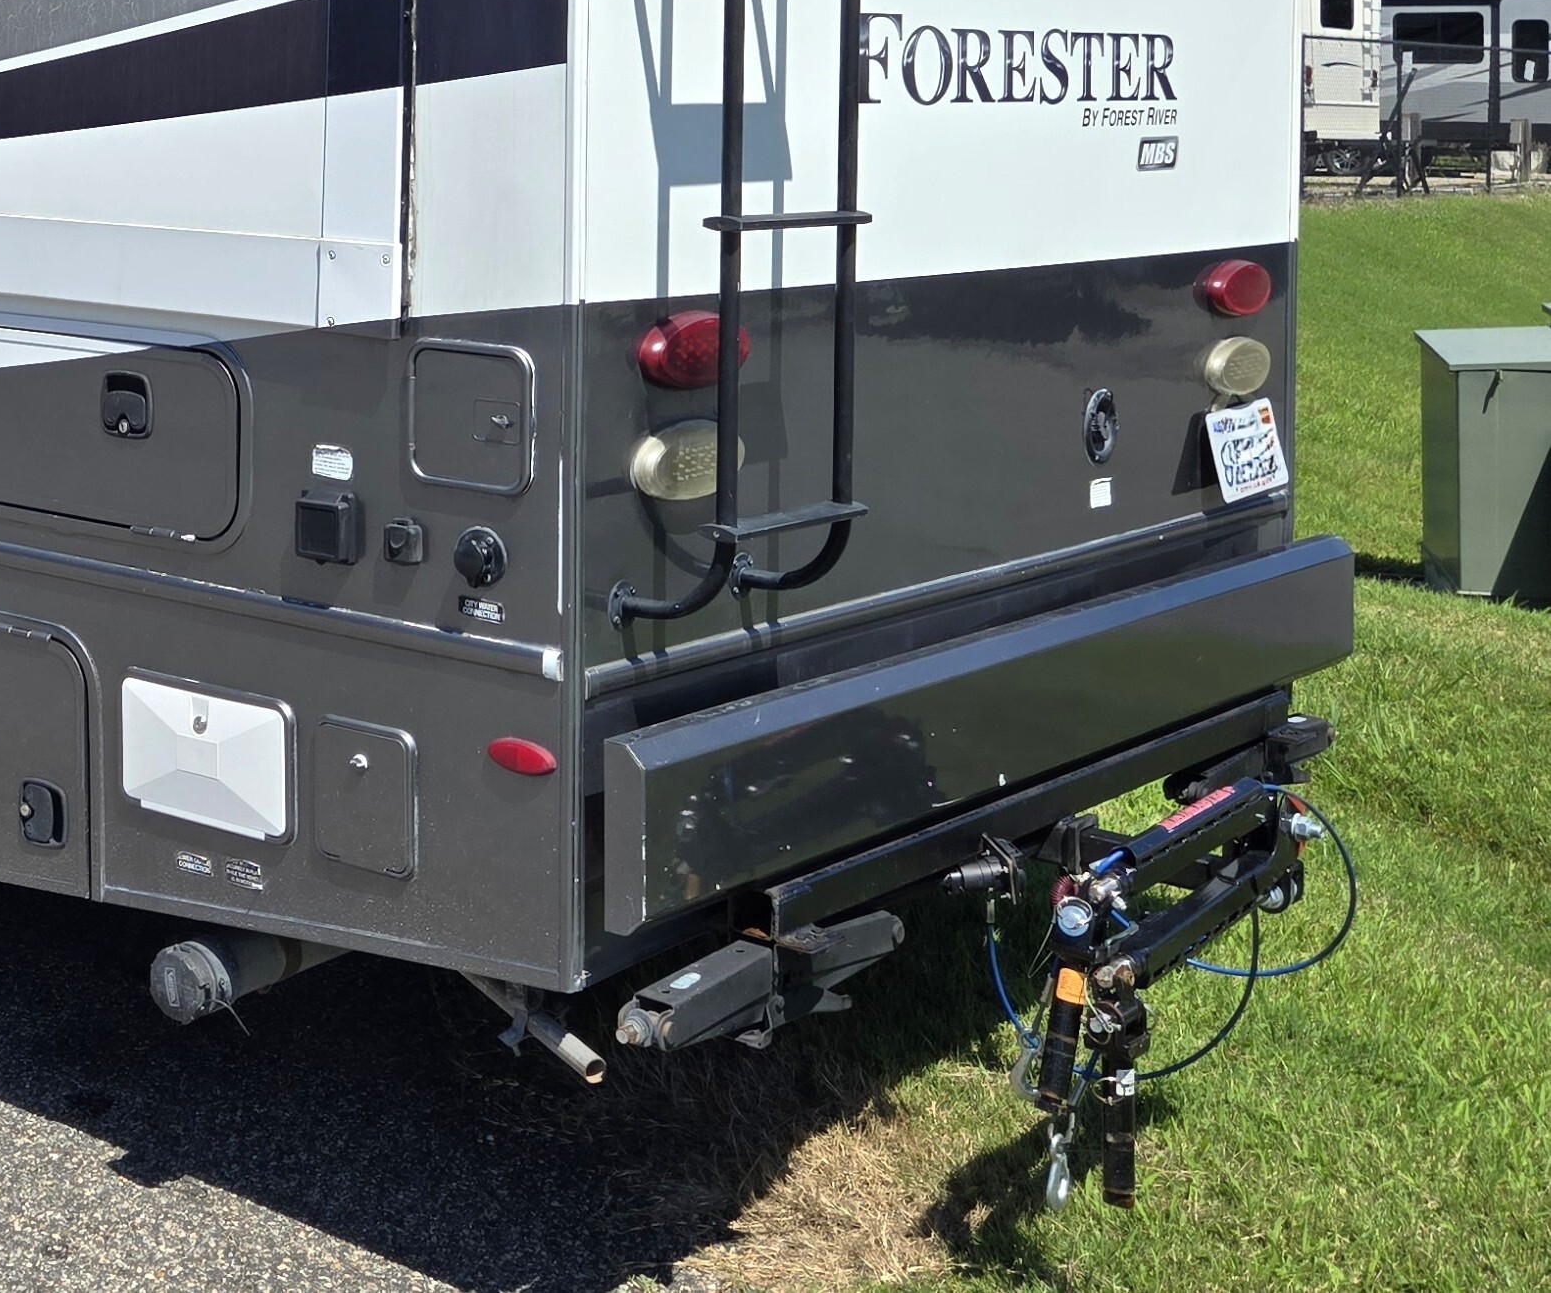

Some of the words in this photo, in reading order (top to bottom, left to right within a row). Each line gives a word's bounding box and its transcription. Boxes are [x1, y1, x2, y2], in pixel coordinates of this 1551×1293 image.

[858, 12, 1178, 106] FORESTER
[1081, 107, 1099, 127] BY
[1101, 107, 1145, 127] FOREST
[1146, 106, 1178, 126] RIVER
[1139, 142, 1176, 165] MBS
[462, 606, 502, 621] CONNECTION
[464, 599, 479, 608] CITY
[478, 601, 499, 613] WATER
